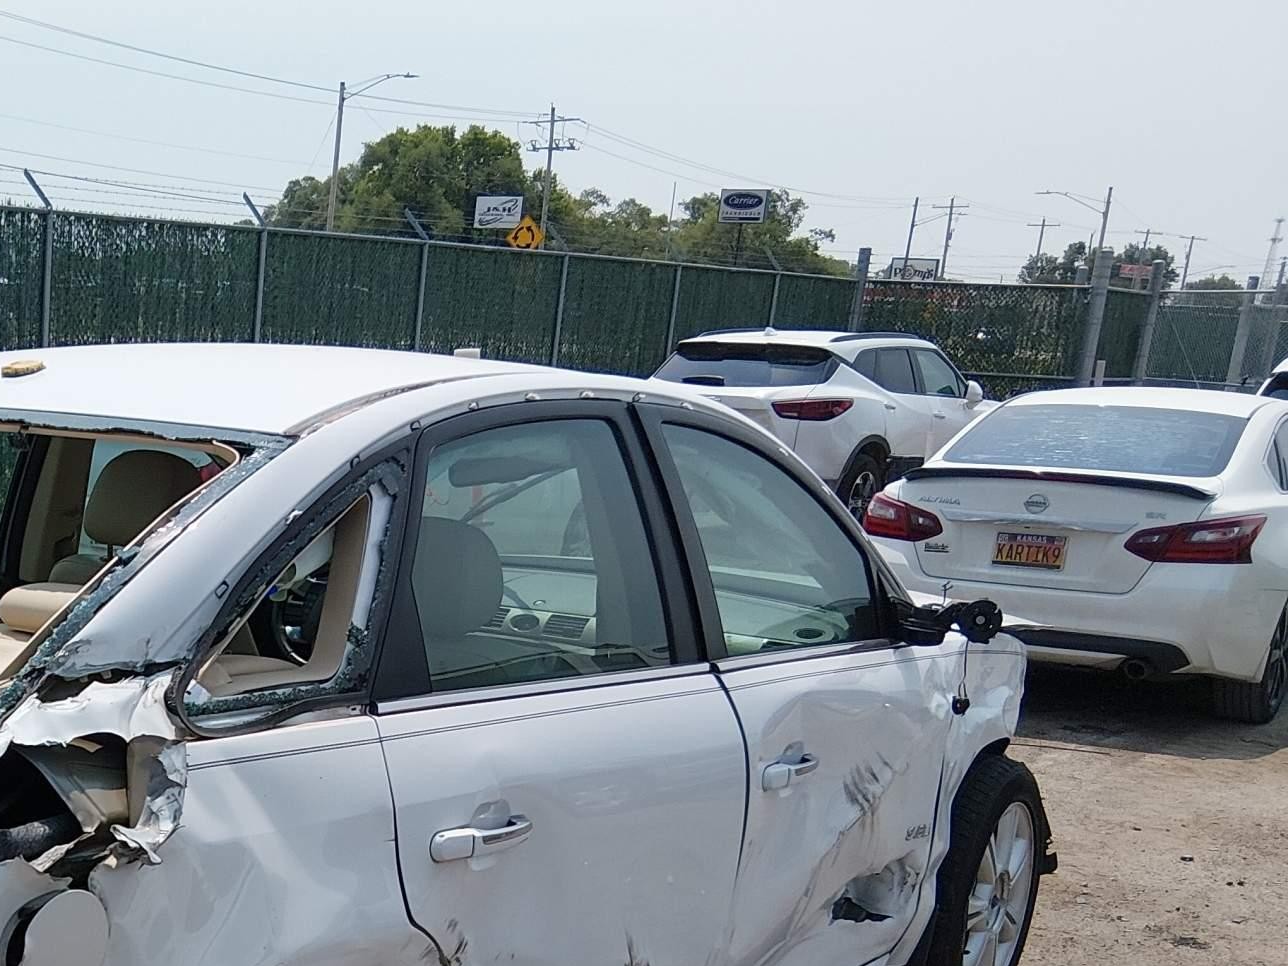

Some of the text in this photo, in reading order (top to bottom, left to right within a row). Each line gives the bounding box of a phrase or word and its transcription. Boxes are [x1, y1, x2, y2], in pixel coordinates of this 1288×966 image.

[728, 196, 760, 205] Carrier
[1016, 535, 1047, 543] KANSAS
[995, 544, 1061, 564] KARTIK9
